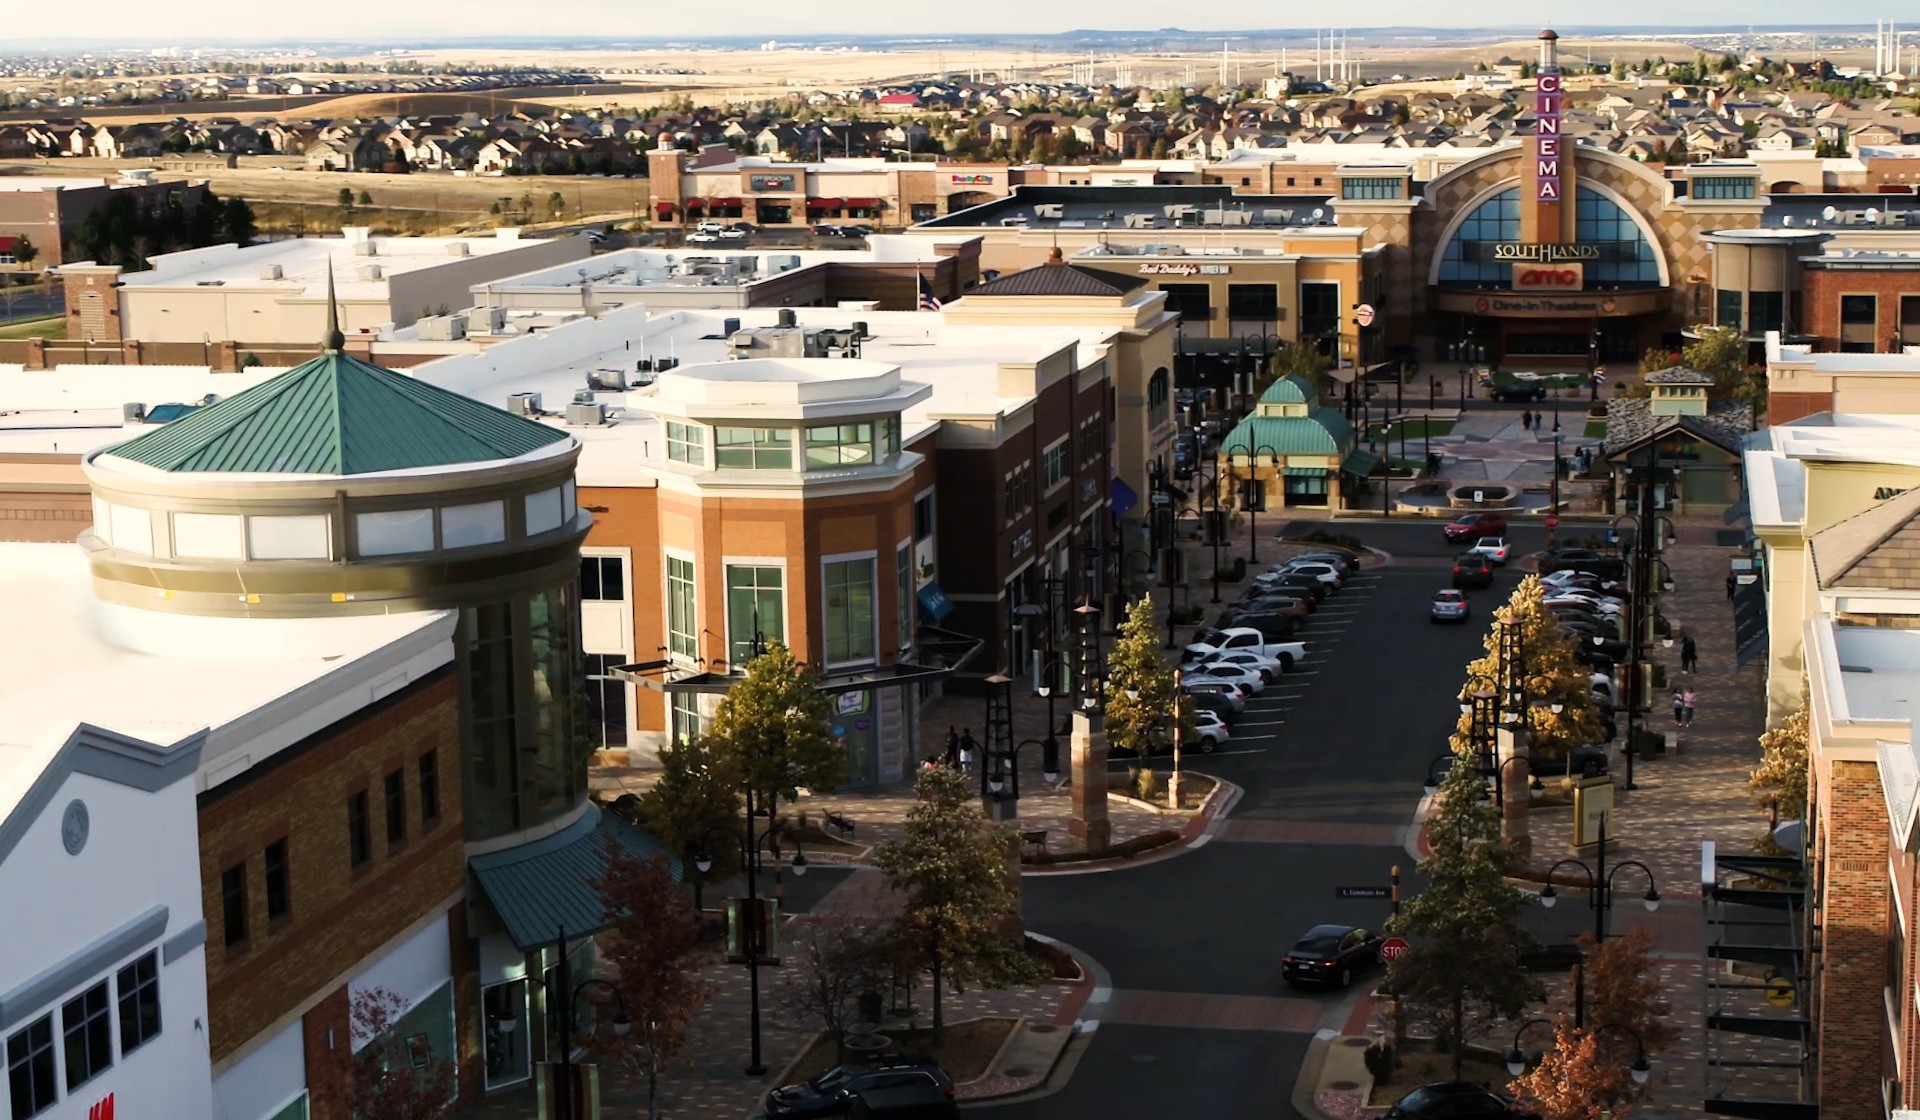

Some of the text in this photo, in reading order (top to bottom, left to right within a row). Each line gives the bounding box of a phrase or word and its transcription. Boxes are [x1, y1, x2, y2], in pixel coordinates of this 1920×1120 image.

[1539, 76, 1557, 198] CINEMA
[1494, 244, 1600, 262] SOUTHLANDS
[1138, 263, 1160, 274] Bad
[1159, 263, 1198, 277] Daddy's
